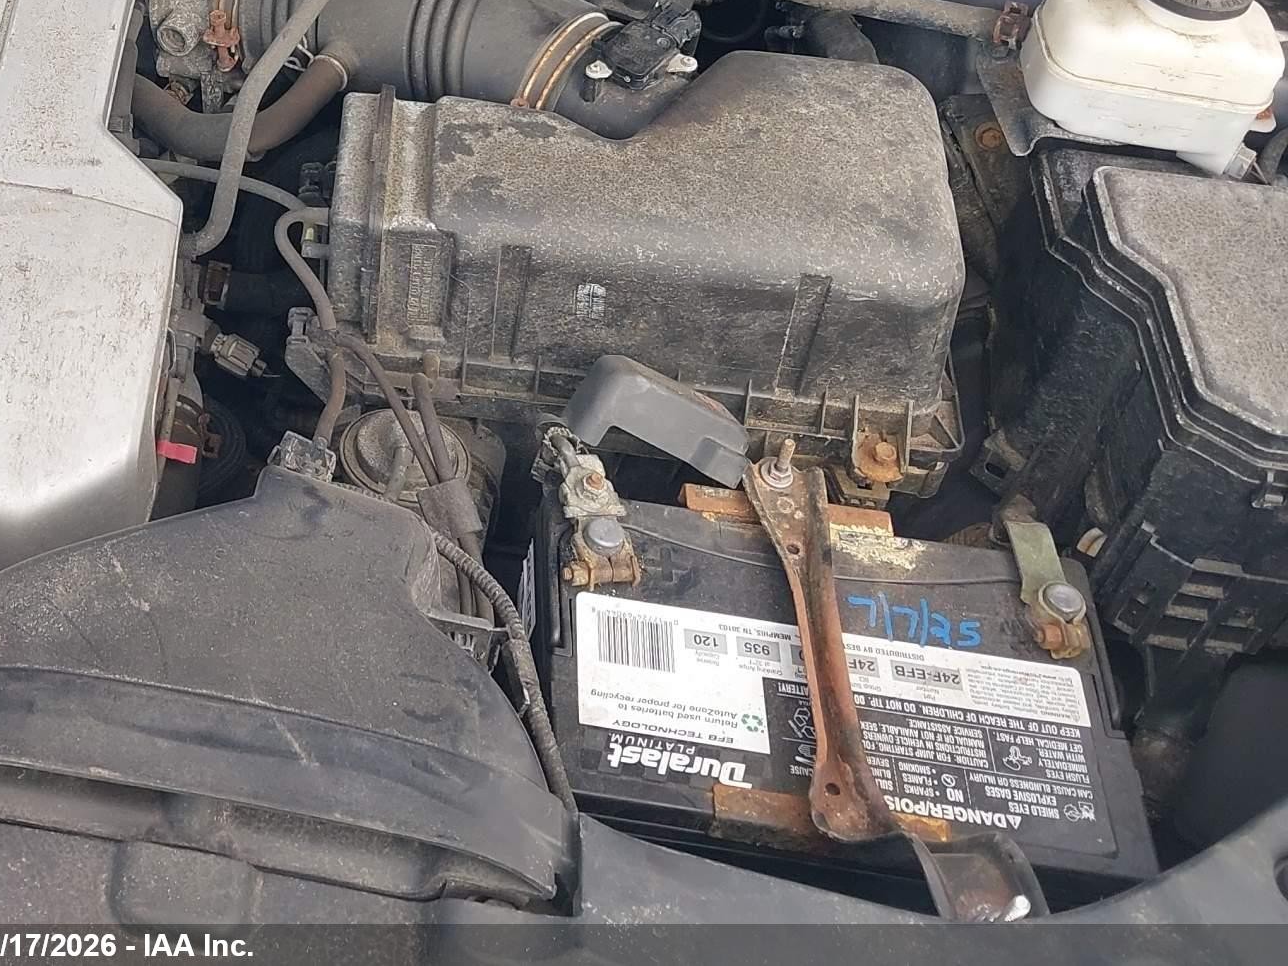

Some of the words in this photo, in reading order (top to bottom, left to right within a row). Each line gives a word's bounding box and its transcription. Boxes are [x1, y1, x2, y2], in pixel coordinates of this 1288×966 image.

[846, 592, 982, 647] 7/7/25
[741, 626, 752, 635] TN
[752, 627, 791, 641] MEMPHIS,
[693, 632, 718, 648] 120
[743, 639, 770, 656] 935
[863, 645, 872, 654] BY
[875, 646, 924, 661] DISTRIBUTED
[848, 657, 875, 672] 24F
[894, 663, 960, 685] 24F-EFB
[590, 687, 634, 704] recycling
[777, 681, 808, 696] ATTERY!
[617, 701, 628, 711] to
[637, 694, 669, 708] proper
[672, 701, 685, 712] for
[867, 695, 883, 706] TIP.
[884, 698, 901, 709] NOT
[903, 701, 916, 711] DO
[630, 703, 673, 719] batteries
[676, 710, 700, 723] used
[688, 703, 737, 720] AutoZone
[918, 703, 963, 720] CHILDREN.
[964, 710, 976, 722] OF
[703, 715, 737, 729] Return
[859, 719, 877, 731] SEEK
[905, 717, 951, 734] ASSISTANCE.
[978, 712, 1006, 727] REACH
[1007, 717, 1024, 730] THE
[1027, 720, 1039, 732] OF
[611, 717, 703, 739] TECHNOLOGY
[919, 729, 935, 741] NOT
[952, 725, 982, 739] SERVICE
[1040, 722, 1057, 735] OUT
[1059, 725, 1080, 738] KEEP
[707, 732, 733, 744] EFB
[894, 735, 924, 749] VEHICLE
[936, 732, 942, 742] IF
[943, 733, 954, 744] OR
[954, 735, 984, 748] MANUAL
[991, 729, 1013, 742] FAST.
[1014, 733, 1034, 745] HELP
[925, 740, 932, 750] IN
[934, 741, 986, 758] INSTRUCTIONS
[1034, 736, 1067, 751] MEDICAL
[1068, 741, 1083, 754] GET
[914, 747, 934, 760] JUMP
[935, 751, 950, 763] FOR
[1035, 746, 1066, 760] WATER.
[1066, 751, 1085, 763] WITH
[608, 741, 753, 790] Duralast
[865, 755, 889, 767] SEVER
[897, 760, 931, 774] SMOKING
[952, 753, 987, 768] CAUTION:
[1038, 757, 1088, 773] IMMEDIATELY
[901, 771, 932, 786] FLAMES
[969, 770, 996, 784] INJURY
[997, 775, 1008, 786] OR
[1045, 768, 1064, 779] EYES
[1065, 772, 1089, 783] FLUSH
[903, 783, 933, 797] SPARKS
[1009, 776, 1051, 792] BLINDNESS
[1052, 784, 1075, 796] CAUSE
[946, 787, 963, 802] NO
[984, 784, 1010, 799] GASES
[1012, 789, 1056, 806] EXPLOSIVE
[1076, 788, 1093, 799] CAN
[1007, 800, 1029, 815] EYES
[1031, 804, 1059, 819] SHIELD
